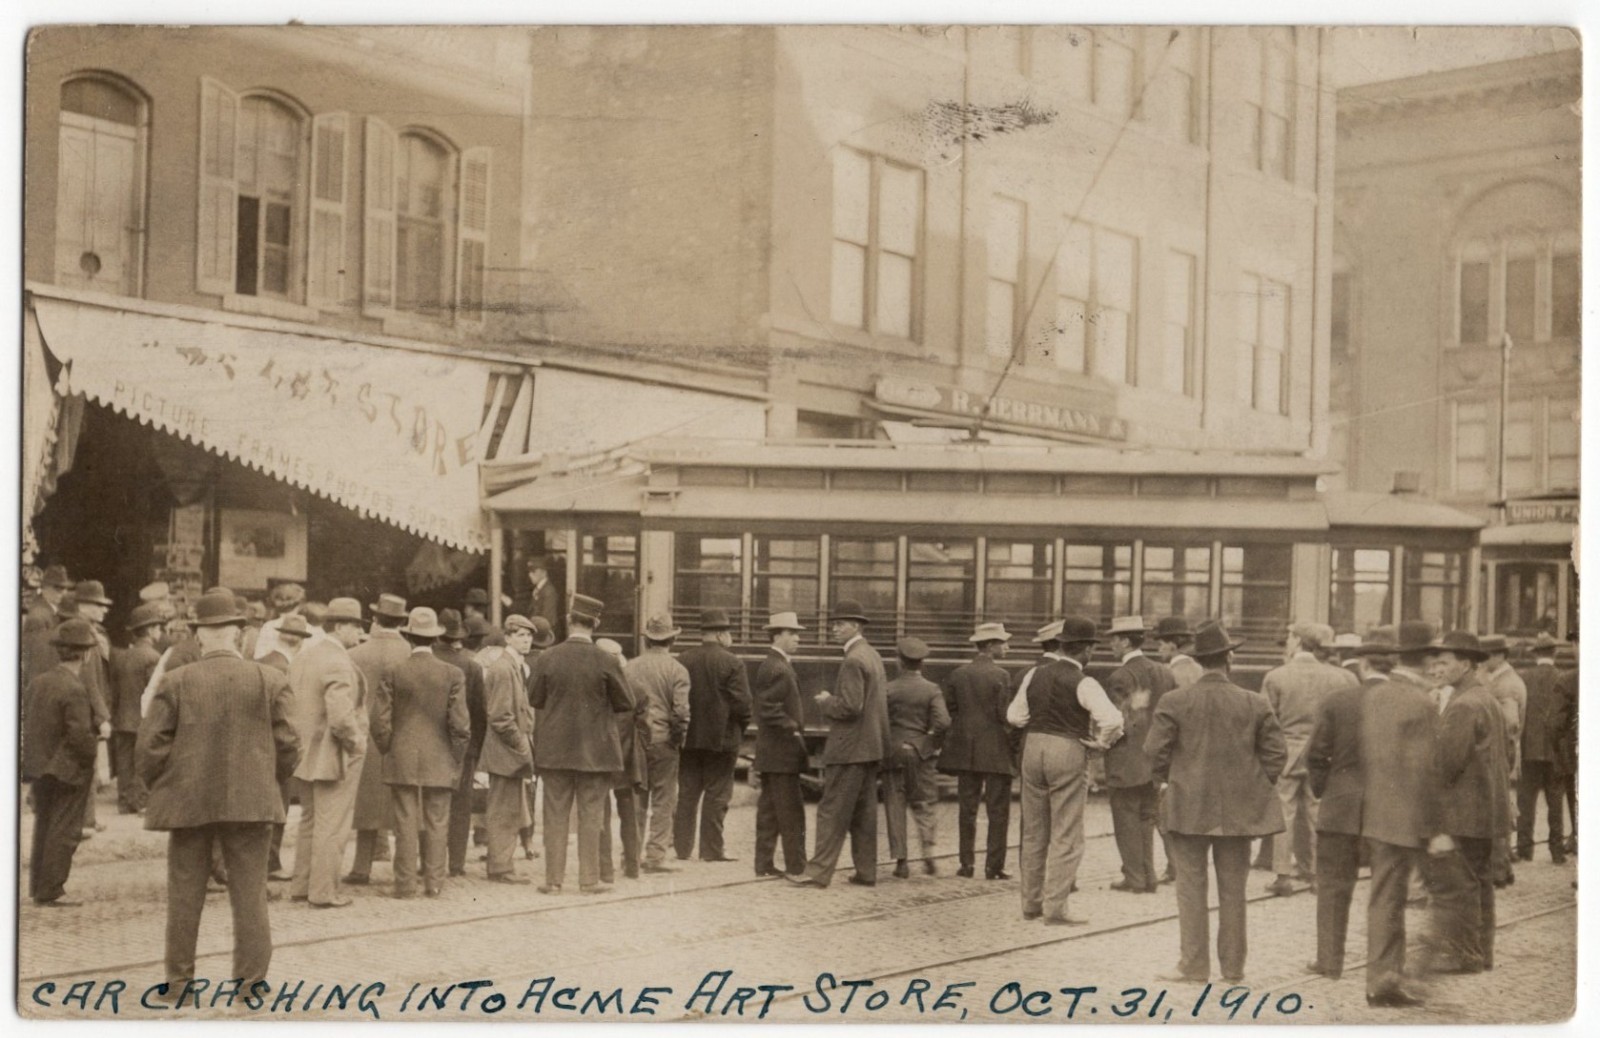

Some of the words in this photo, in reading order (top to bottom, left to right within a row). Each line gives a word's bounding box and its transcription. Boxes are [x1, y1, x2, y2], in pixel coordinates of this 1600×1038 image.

[114, 378, 209, 436] PICTURE
[238, 433, 315, 480] FRAMES
[357, 382, 476, 476] STORE
[32, 979, 127, 1014] CAR
[140, 978, 386, 1019] CRASHING
[400, 979, 507, 1013] INTO
[516, 976, 673, 1014] ACME
[685, 970, 794, 1018] ART
[802, 972, 976, 1020] STORE,
[989, 981, 1098, 1018] OCT.
[1110, 987, 1174, 1022] 31,
[1191, 983, 1315, 1020] 1910.
